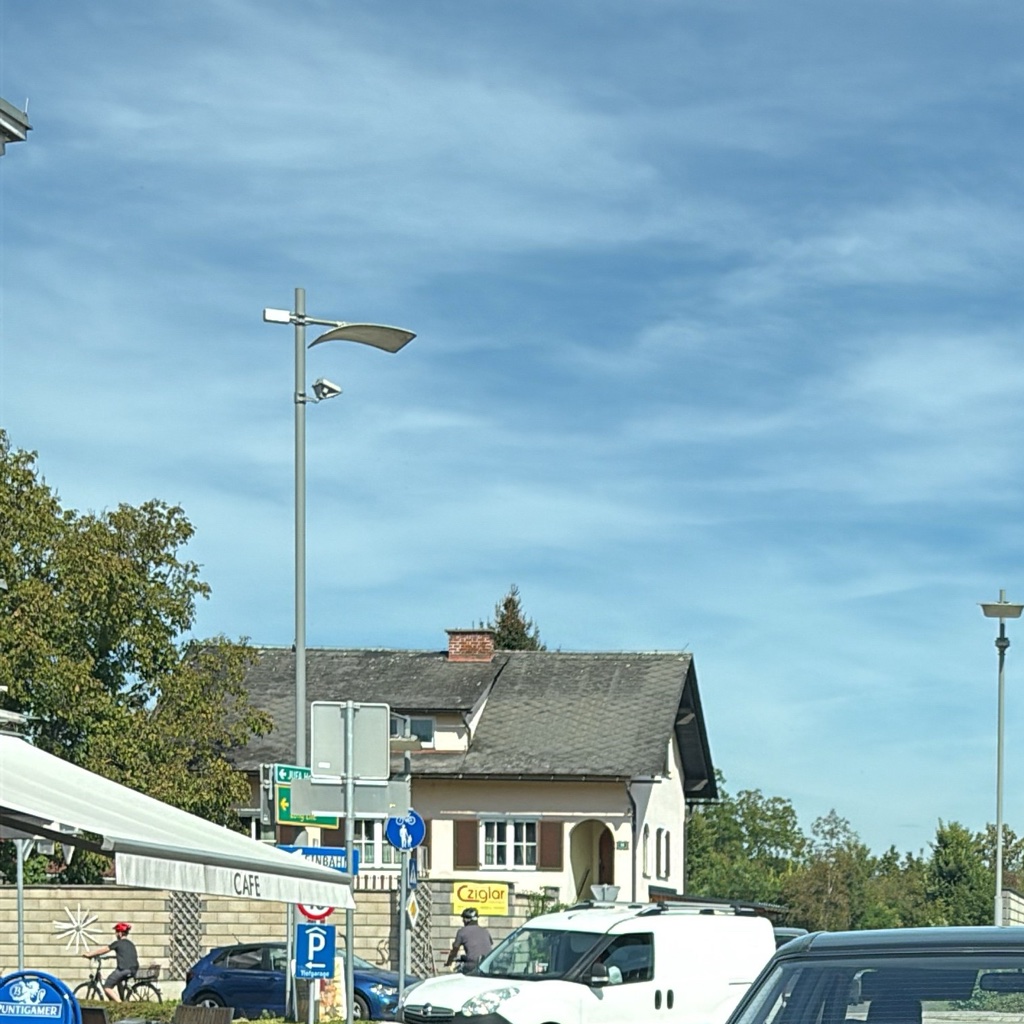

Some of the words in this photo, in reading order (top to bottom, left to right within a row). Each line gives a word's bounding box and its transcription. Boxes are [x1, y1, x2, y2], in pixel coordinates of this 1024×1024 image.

[233, 872, 261, 897] CAFE
[457, 885, 505, 903] Cziglar
[300, 969, 330, 978] Tiefgarage
